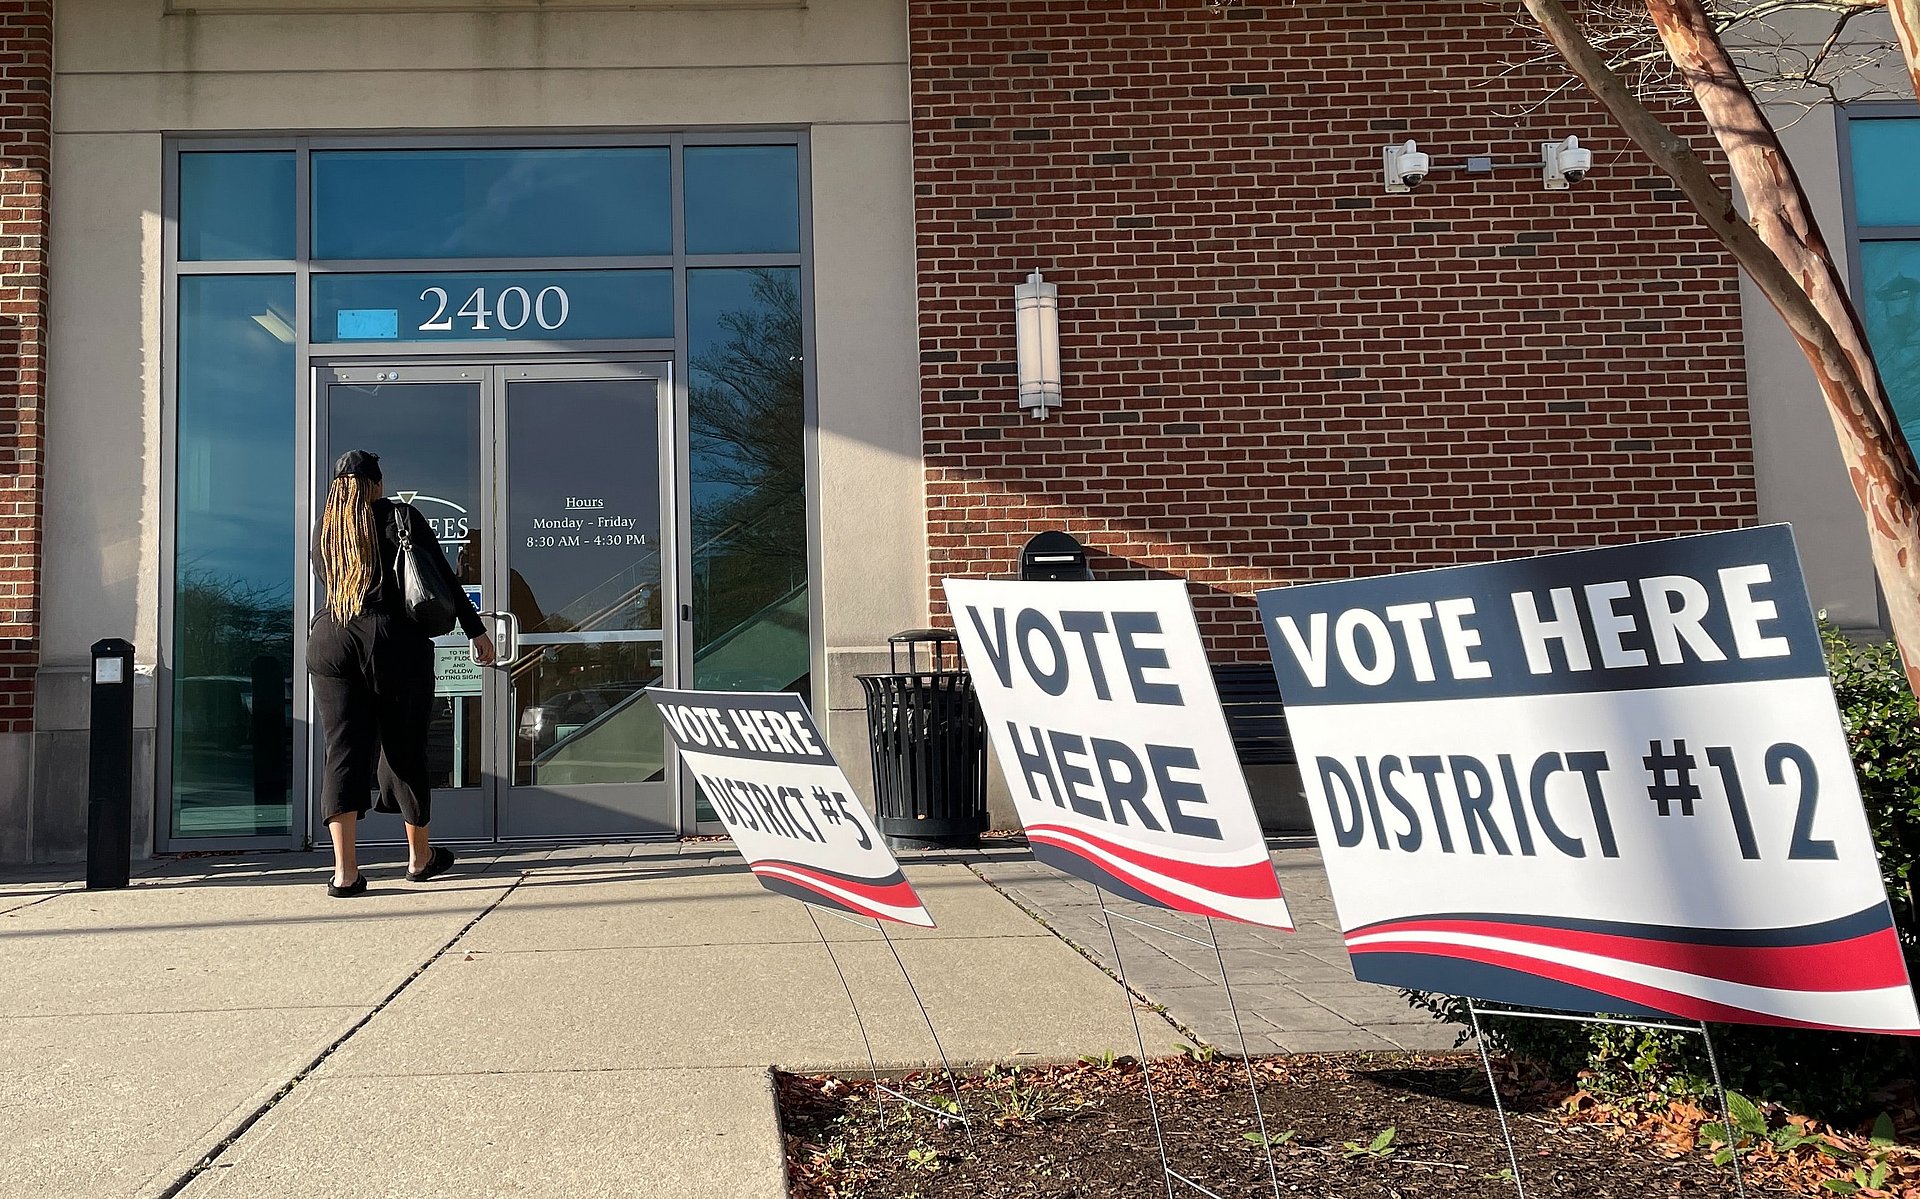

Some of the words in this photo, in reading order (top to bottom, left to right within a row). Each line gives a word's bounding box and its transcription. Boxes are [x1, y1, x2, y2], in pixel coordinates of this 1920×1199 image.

[418, 286, 570, 332] 2400
[532, 517, 584, 530] Monday
[597, 516, 637, 530] Friday
[565, 497, 604, 508] Hours
[526, 535, 555, 548] 8:30
[558, 535, 580, 547] AM
[593, 535, 622, 546] 4:30
[625, 534, 646, 546] PM
[965, 605, 1186, 707] VOTE
[1275, 596, 1494, 688] VOTE
[1510, 563, 1792, 675] HERE
[656, 703, 740, 750] VOTE
[727, 709, 824, 756] HERE
[701, 773, 827, 844] DISTRICT
[810, 785, 873, 851] #5
[1006, 720, 1224, 840] HERE
[1315, 750, 1622, 858] DISTRICT
[1642, 738, 1840, 861] #12
